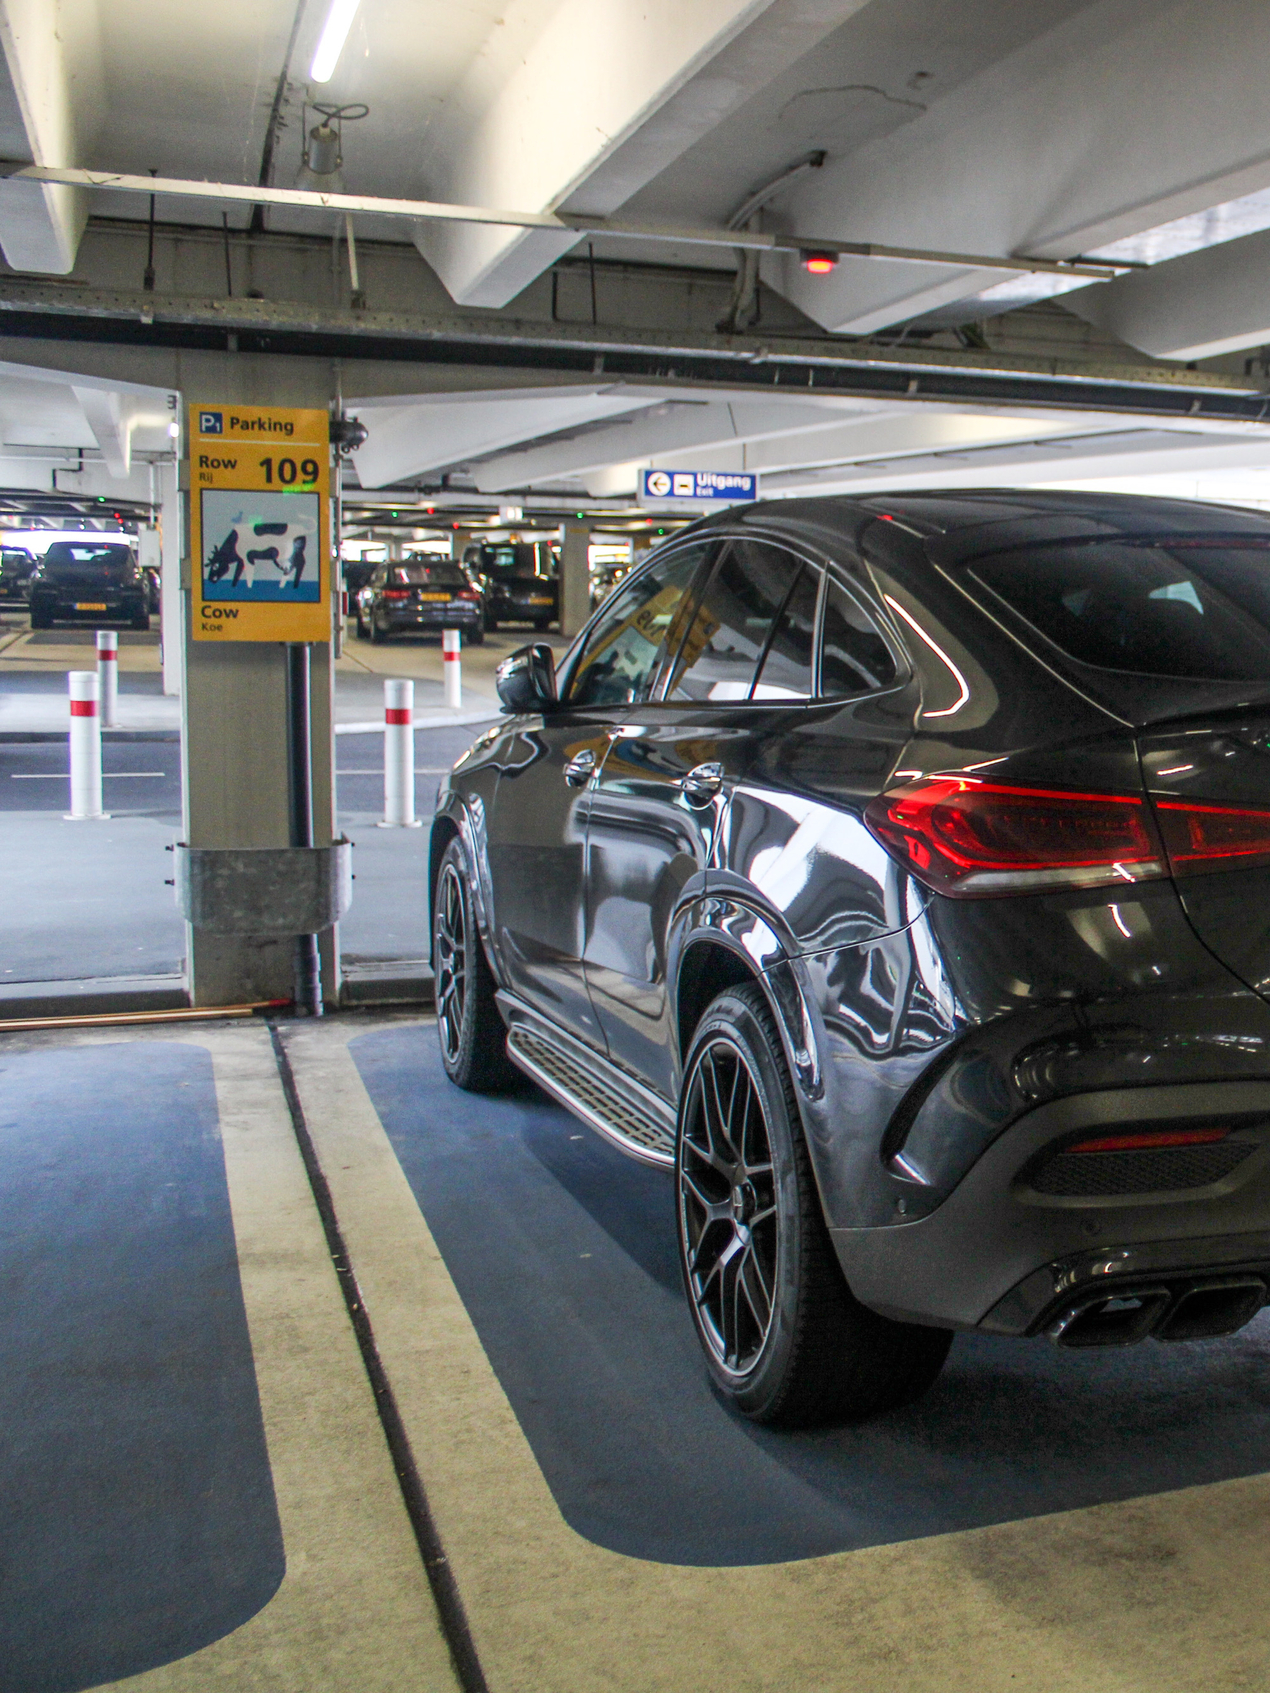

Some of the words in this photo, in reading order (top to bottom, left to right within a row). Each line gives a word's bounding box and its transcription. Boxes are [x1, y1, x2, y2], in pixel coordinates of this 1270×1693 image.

[230, 417, 294, 435] Parking
[199, 455, 237, 469] Row
[259, 457, 319, 485] 109
[199, 472, 213, 484] Rij
[696, 472, 751, 491] Uitgang
[696, 486, 714, 497] Exit
[201, 605, 238, 619] Cow
[201, 622, 223, 631] Koe
